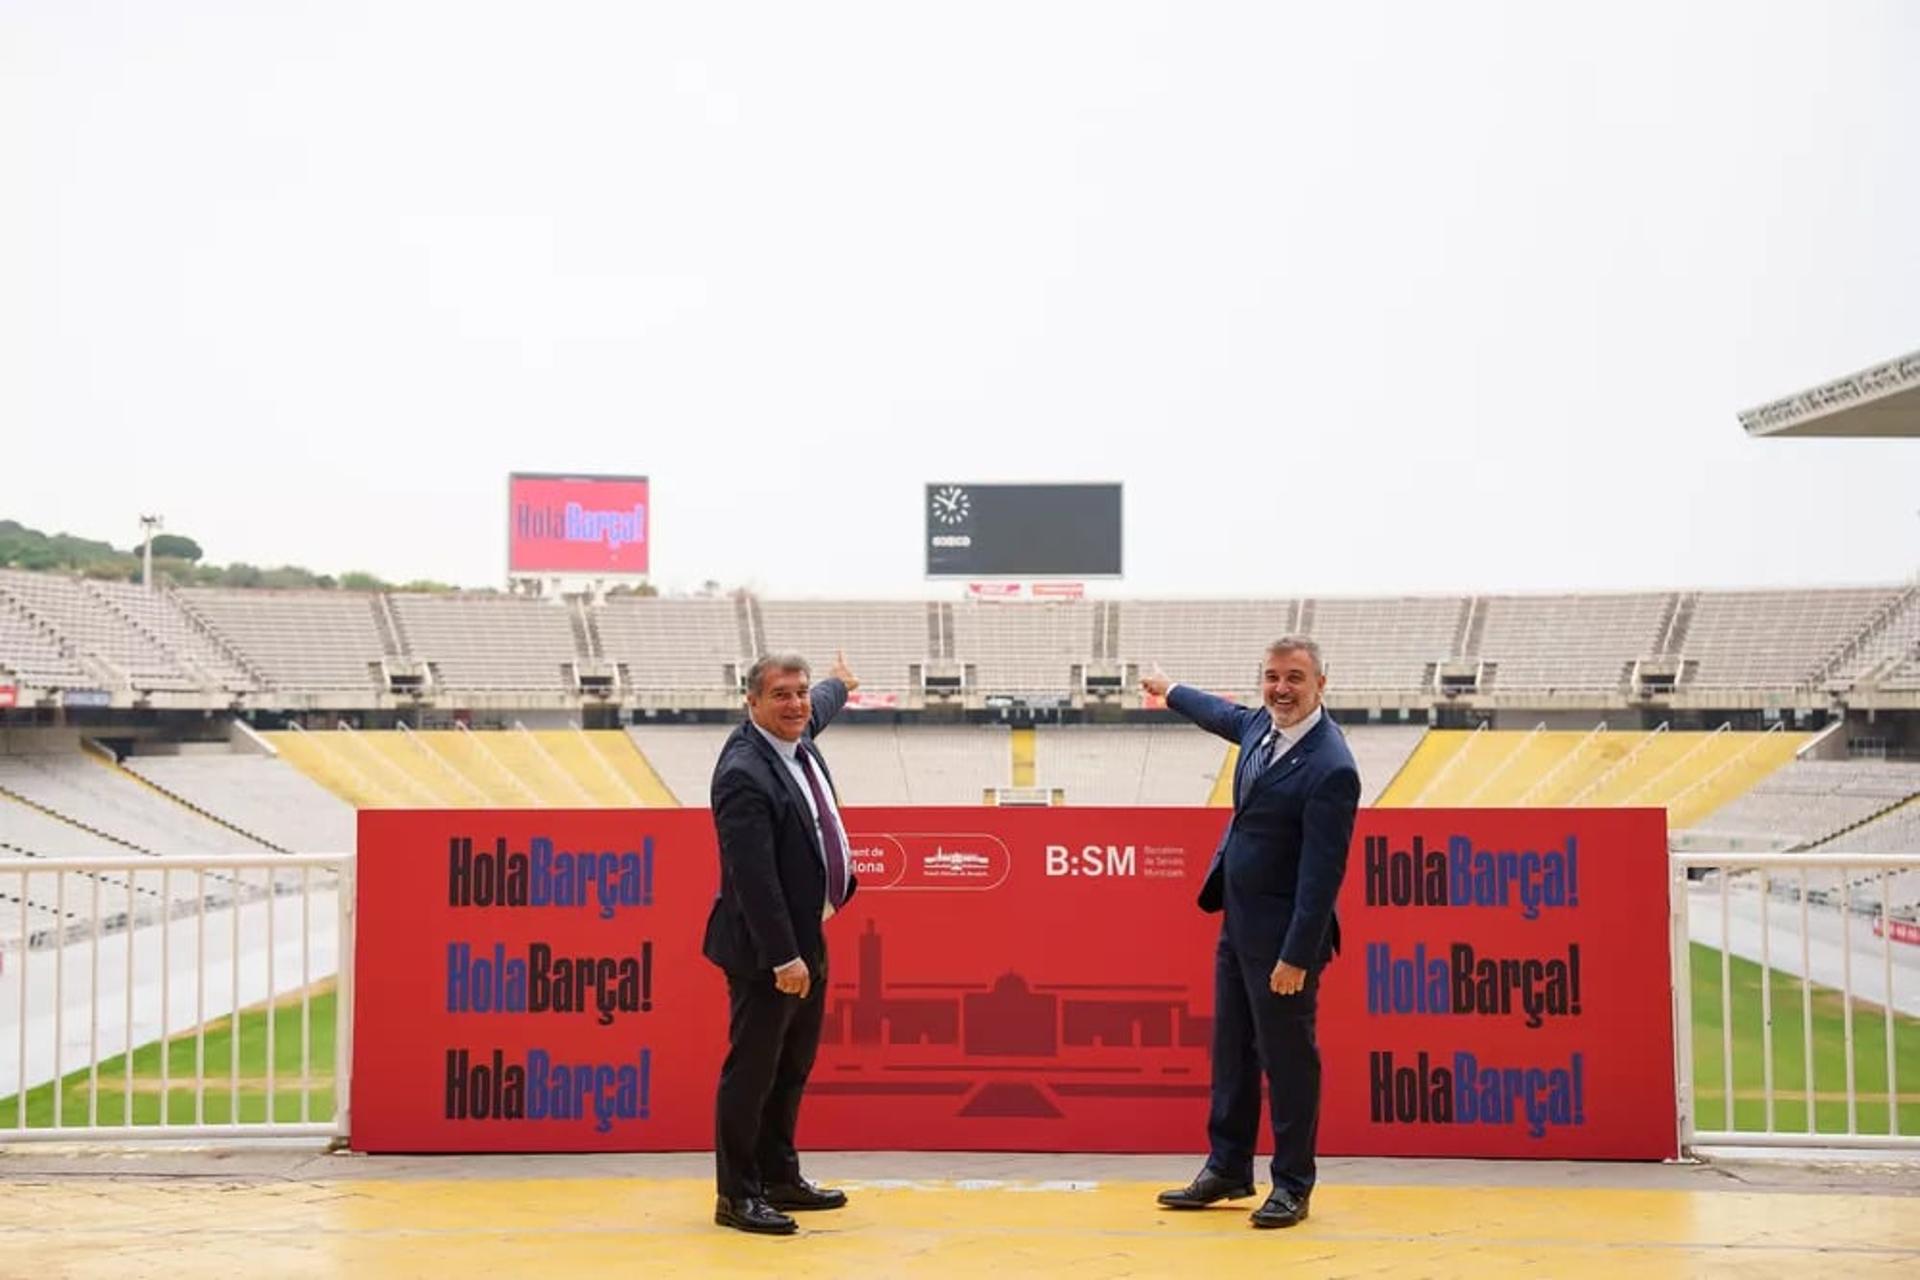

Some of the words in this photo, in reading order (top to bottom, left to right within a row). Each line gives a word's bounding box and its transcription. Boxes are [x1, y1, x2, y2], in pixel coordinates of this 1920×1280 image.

[518, 501, 645, 550] HolaBarça!
[449, 837, 654, 920] HolaBarça!
[1046, 845, 1136, 876] B:SM
[1365, 835, 1579, 920] HolaBarça!
[447, 941, 652, 1025] HolaBarça!
[1366, 943, 1582, 1028] HolaBarça!
[446, 1048, 651, 1132] HolaBarça!
[1370, 1051, 1585, 1138] HolaBarça!
